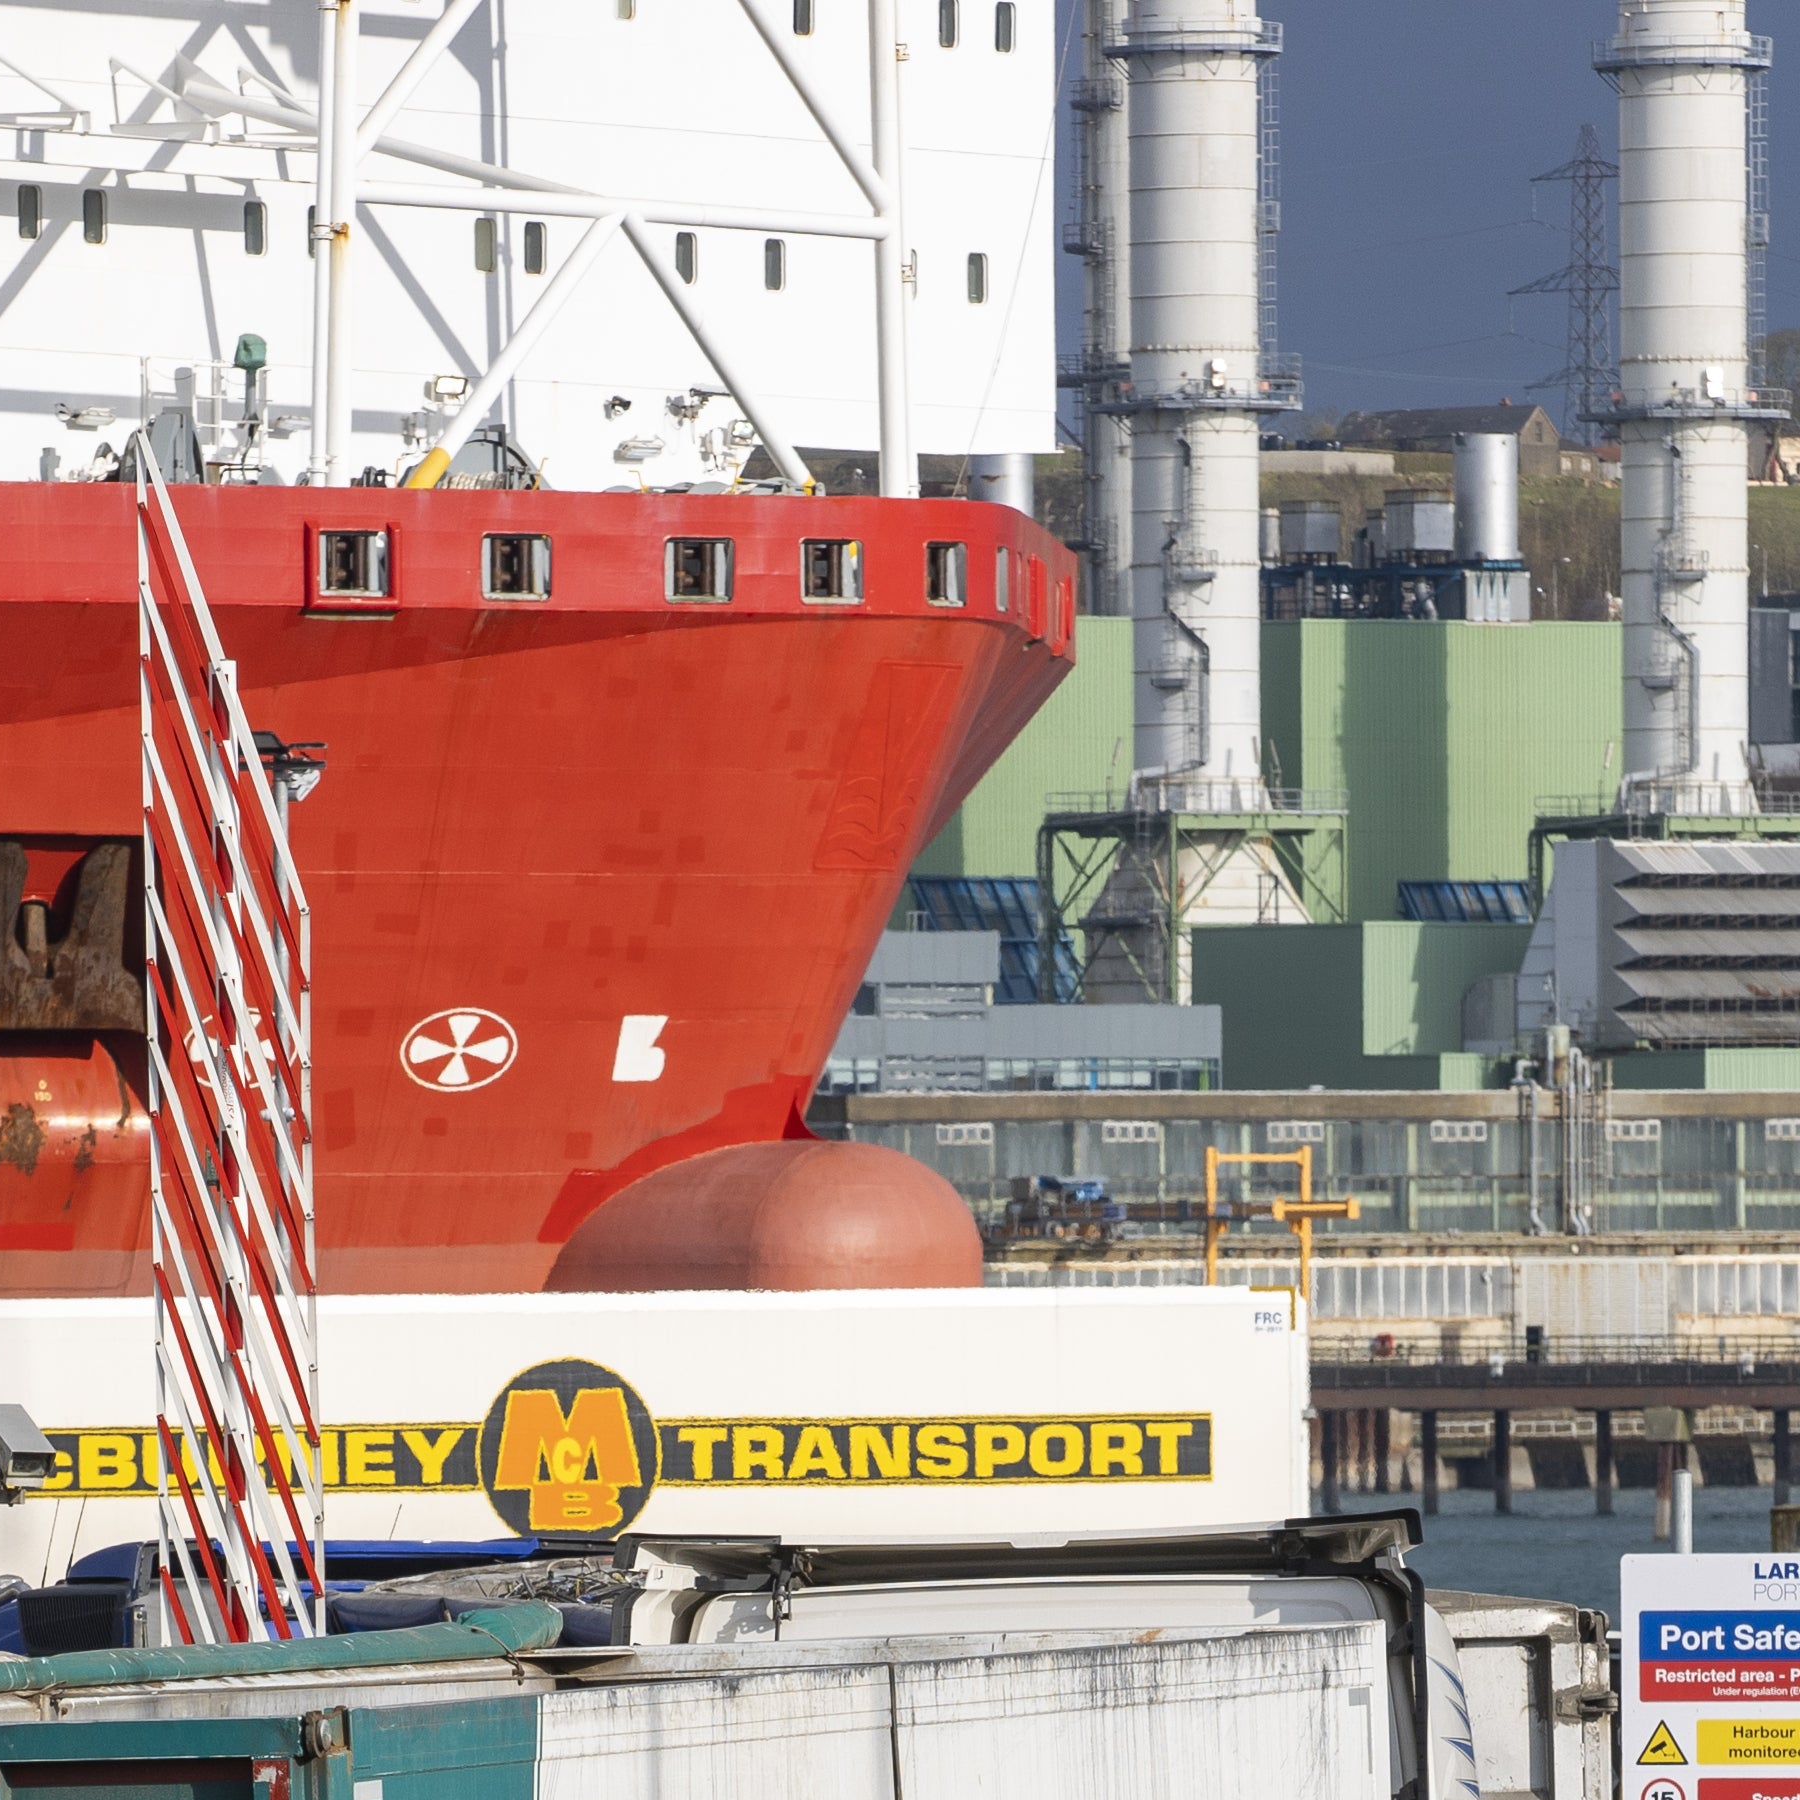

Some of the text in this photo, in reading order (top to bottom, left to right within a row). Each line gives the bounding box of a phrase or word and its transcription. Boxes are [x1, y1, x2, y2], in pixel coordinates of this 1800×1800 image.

[1254, 1312, 1282, 1324] FRC
[678, 1416, 1198, 1481] TRANSPORT
[1661, 1624, 1725, 1651] Port
[1655, 1668, 1736, 1683] Restricted
[1740, 1671, 1774, 1682] area
[1712, 1686, 1741, 1696] Under
[1742, 1686, 1788, 1698] regulation
[1733, 1726, 1796, 1738] Harbour
